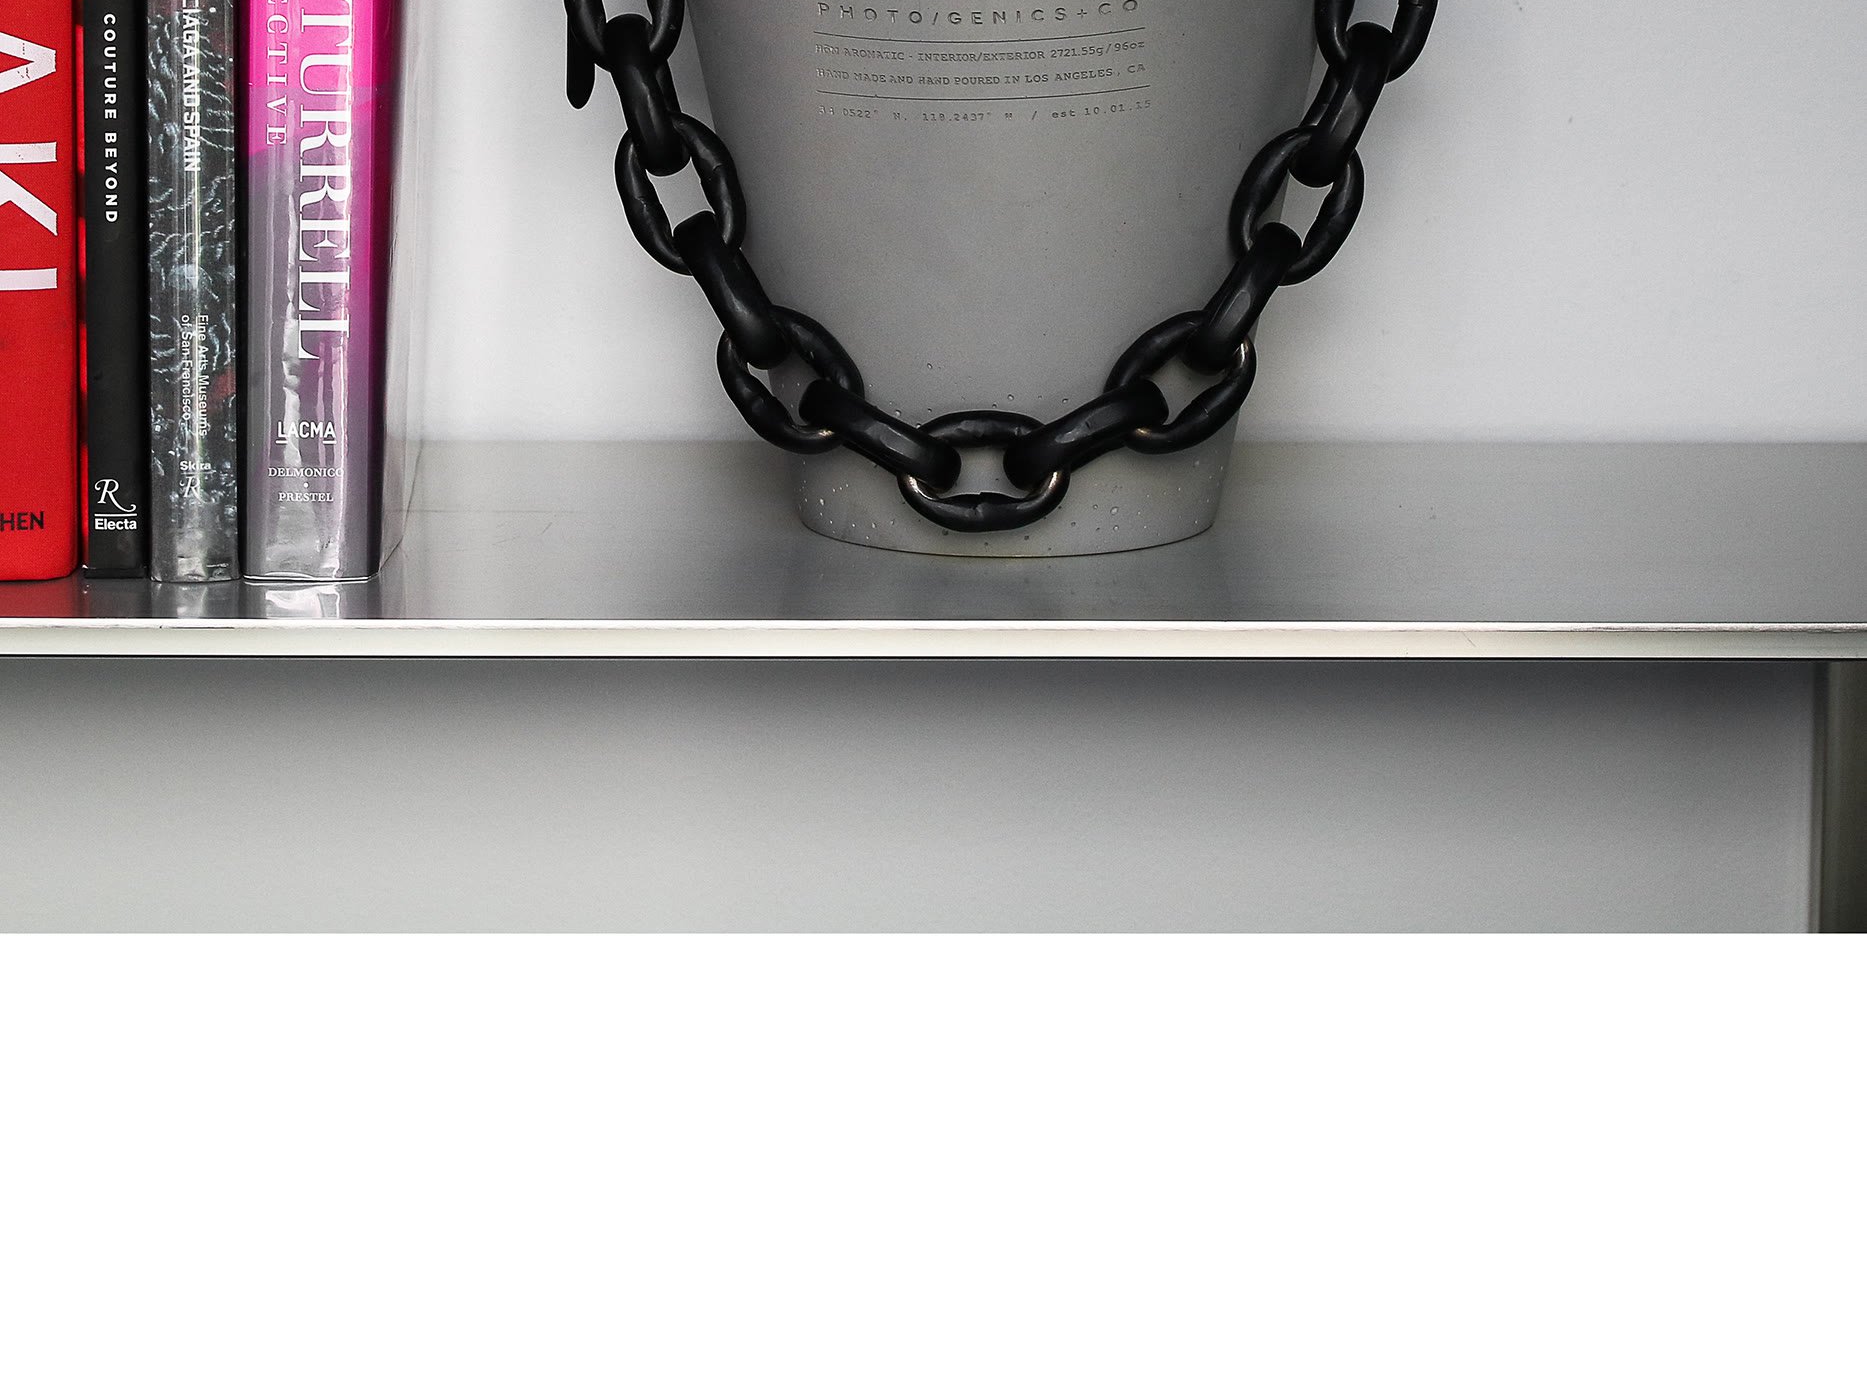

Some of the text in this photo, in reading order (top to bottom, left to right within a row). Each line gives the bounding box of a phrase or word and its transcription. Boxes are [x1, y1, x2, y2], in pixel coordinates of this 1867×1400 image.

[844, 49, 905, 61] AROMATIC
[917, 50, 1046, 63] INTERIOR/EXTERIOR
[1050, 41, 1146, 59] 2721.55g/96oz
[182, 64, 200, 107] AND
[816, 63, 1147, 86] HAND MADE AND HAND POURED IN LOS ANGELES, CA
[102, 13, 120, 223] COUTURE BEYOND
[1051, 109, 1077, 119] est
[182, 111, 200, 172] SPAIN
[180, 314, 193, 421] of San Francisco
[197, 314, 209, 437] Fine Arts Museums
[277, 421, 337, 438] LACMA
[179, 460, 212, 471] Skira
[268, 467, 344, 477] DELMONICO
[279, 492, 334, 502] PRESTEL
[94, 518, 137, 530] Electa
